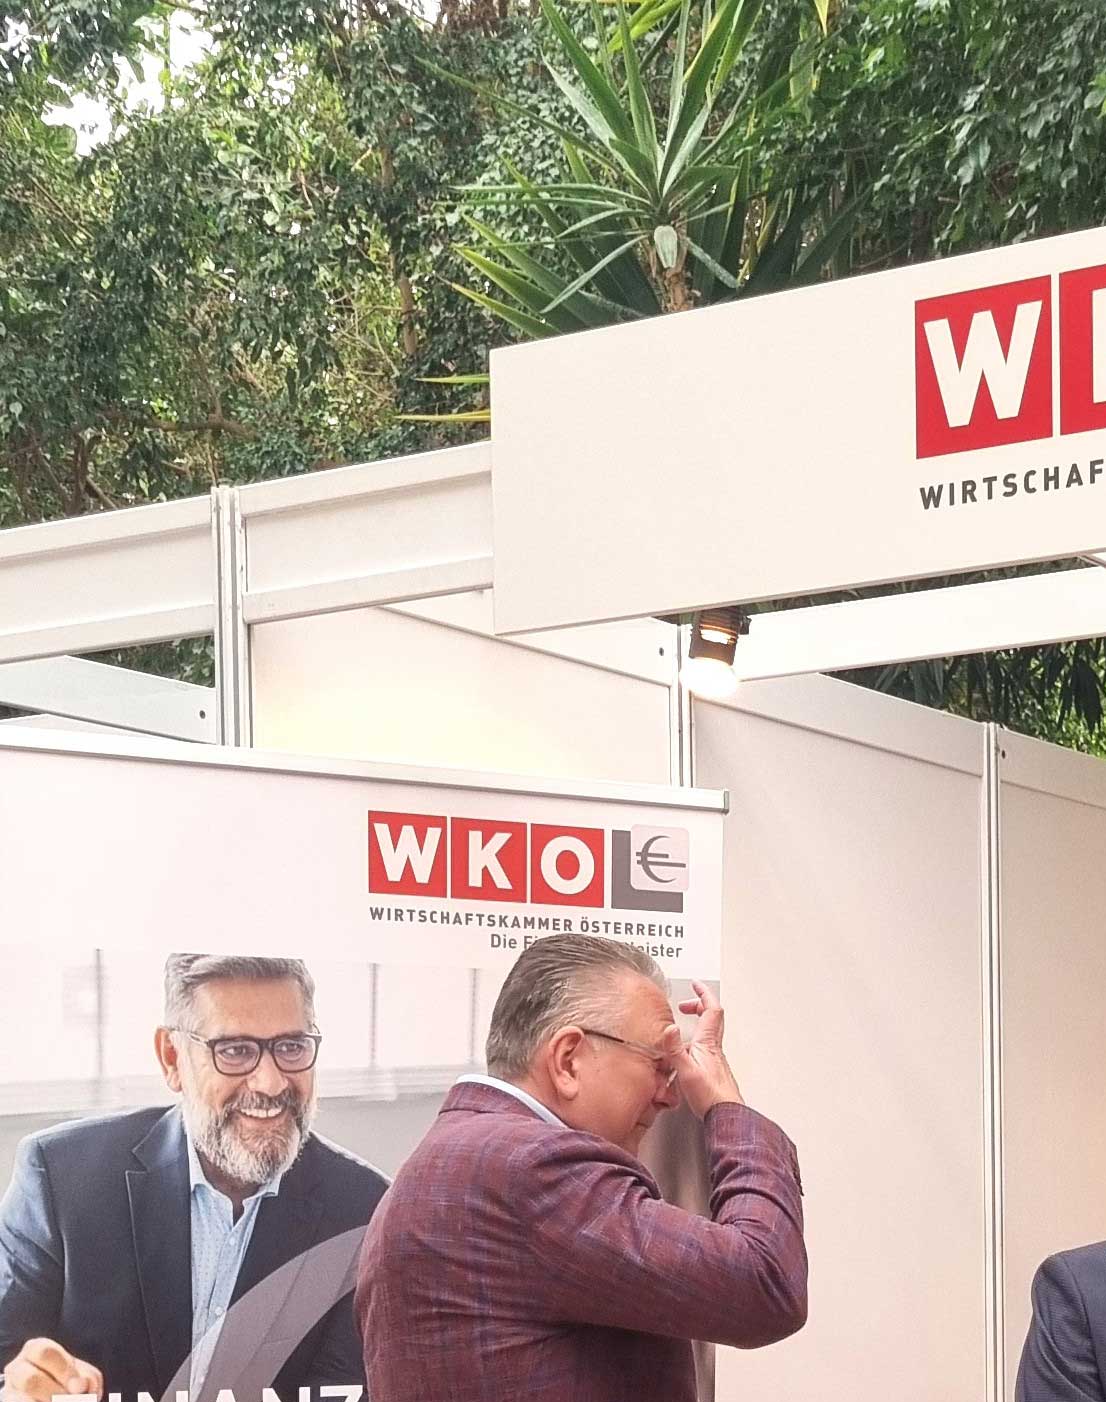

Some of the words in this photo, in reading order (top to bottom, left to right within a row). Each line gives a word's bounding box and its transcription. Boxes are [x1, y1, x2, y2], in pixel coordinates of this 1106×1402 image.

[373, 822, 596, 896] WKO
[369, 906, 573, 933] WIRTSCHAFTSKAMMER
[580, 916, 684, 939] ÖSTERREICH
[490, 934, 518, 949] Die
